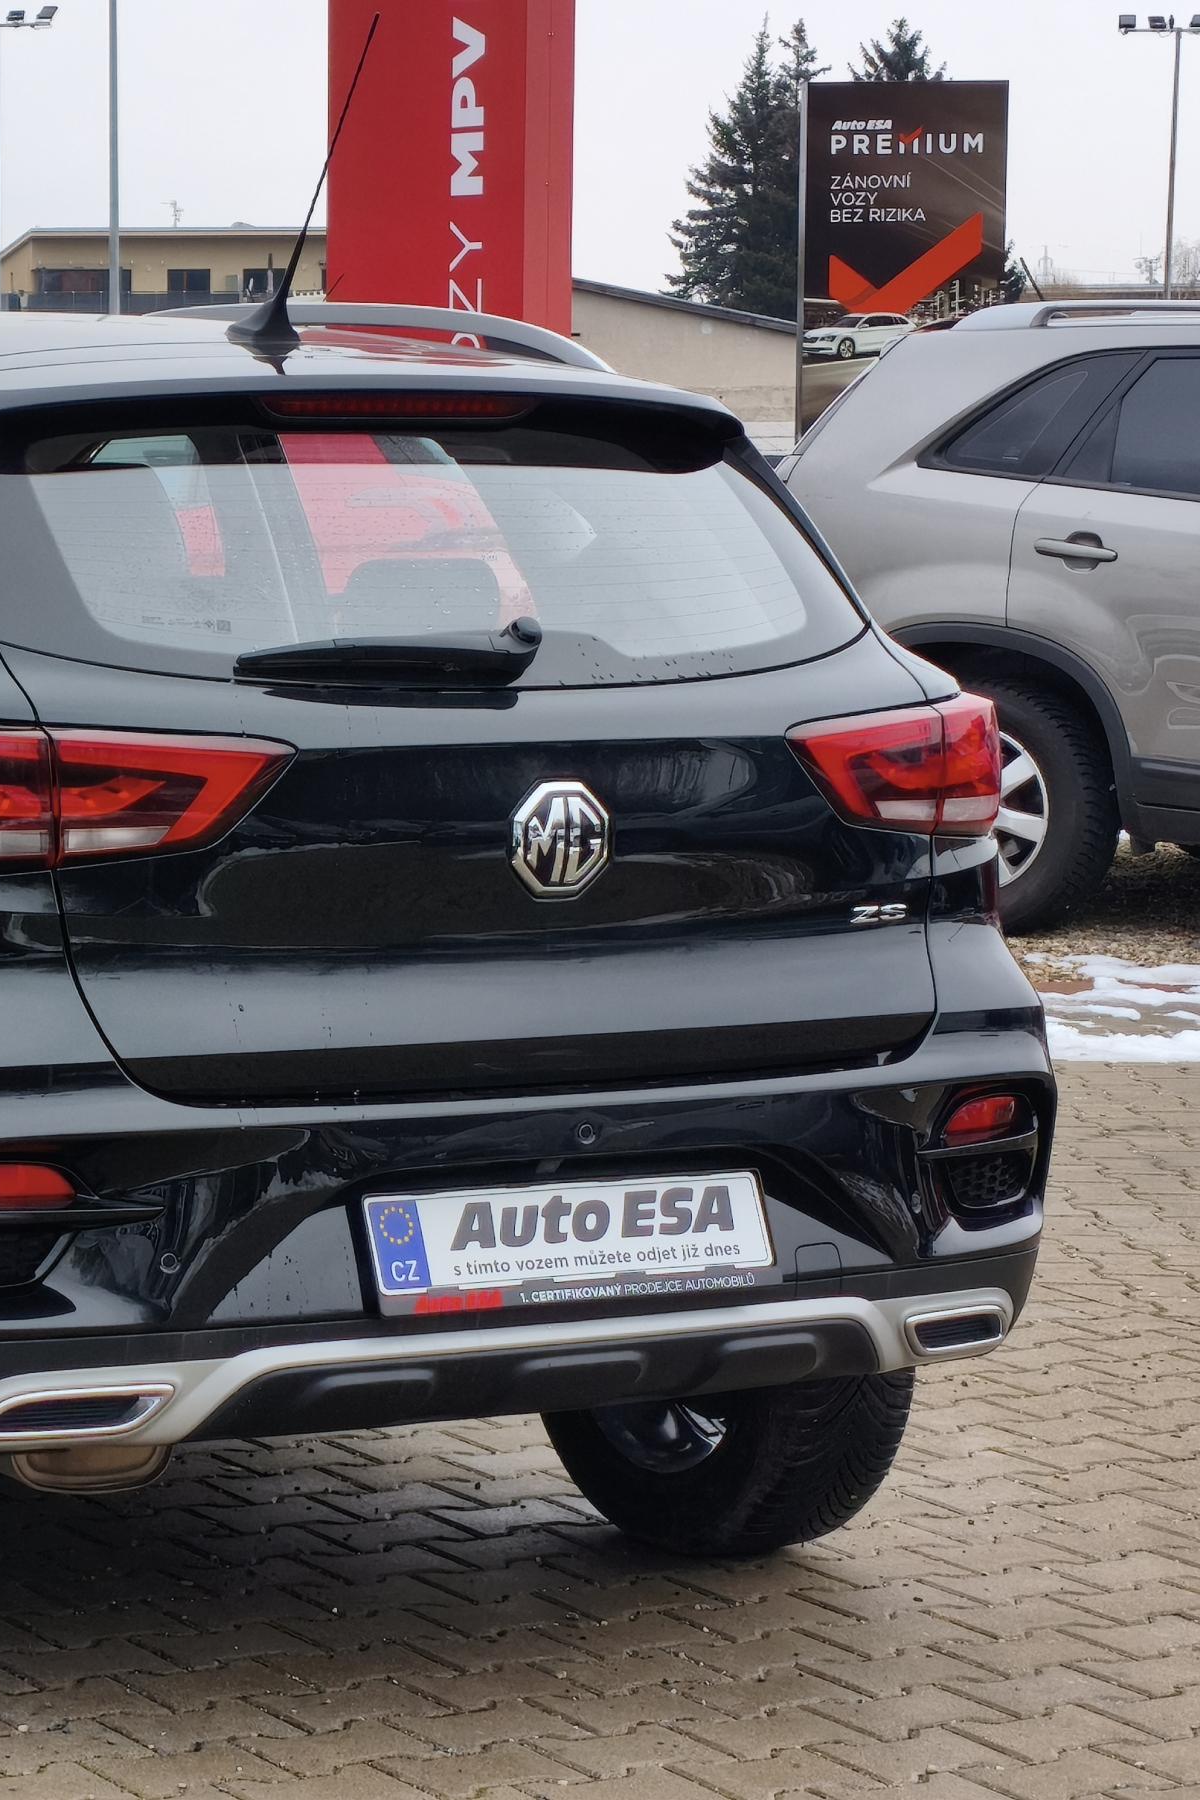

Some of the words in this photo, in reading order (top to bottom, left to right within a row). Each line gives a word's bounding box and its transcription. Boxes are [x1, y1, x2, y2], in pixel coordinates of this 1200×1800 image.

[450, 16, 486, 196] MPV
[831, 120, 866, 130] Auto
[866, 119, 893, 130] ESA
[830, 132, 984, 154] PREMIUM
[830, 172, 911, 189] ZÁNOVNÍ
[830, 192, 878, 206] VOZY
[830, 208, 863, 223] BEZ
[869, 208, 926, 222] RIZIKA
[449, 221, 483, 348] ZY
[527, 796, 602, 884] MG
[850, 903, 907, 923] ZS
[450, 1195, 611, 1251] Auto
[621, 1185, 735, 1238] ESA
[453, 1264, 462, 1277] s
[515, 1256, 570, 1272] vozem
[574, 1248, 632, 1267] můžete
[636, 1245, 681, 1265] odjet
[681, 1242, 701, 1261] již
[704, 1242, 741, 1258] dnes
[391, 1260, 421, 1282] CZ
[519, 1291, 529, 1304] 1.
[531, 1283, 622, 1303] CERTIFIKOVANÝ
[625, 1281, 683, 1297] PRODEJCE
[685, 1271, 755, 1292] AUTOMOBILŮ
